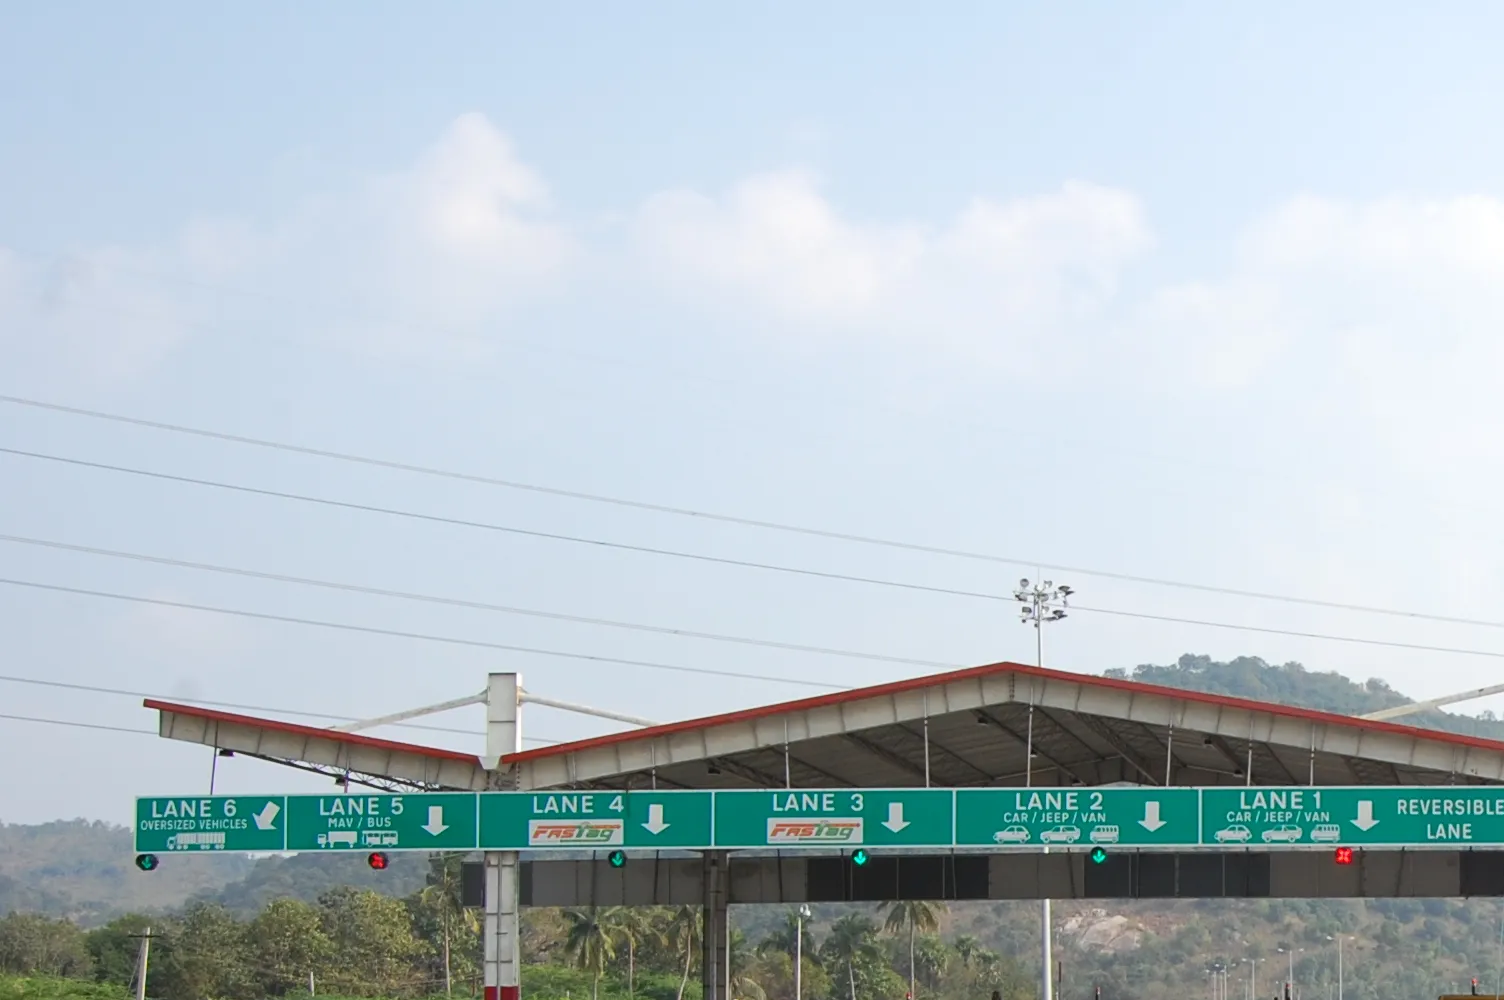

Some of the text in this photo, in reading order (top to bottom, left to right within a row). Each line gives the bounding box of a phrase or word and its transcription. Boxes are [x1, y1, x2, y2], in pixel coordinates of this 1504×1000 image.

[153, 799, 236, 817] LANE 6
[320, 798, 403, 815] LANE 5
[533, 795, 624, 813] LANE 4
[774, 794, 863, 811] LANE 3
[1016, 792, 1102, 810] LANE 2
[1241, 791, 1320, 809] LANE 1
[1398, 800, 1504, 815] REVERSIBLE
[141, 819, 247, 830] OVERSIZED VEHICLES
[329, 818, 352, 827] MAV
[368, 817, 390, 827] BUS
[1004, 813, 1028, 822] CAR
[1041, 813, 1069, 822] JEEP
[1082, 813, 1105, 822] VAN
[1227, 812, 1251, 821] CAR
[1264, 812, 1292, 822] JEEP
[1305, 812, 1329, 822] VAN
[1428, 824, 1472, 839] LANE
